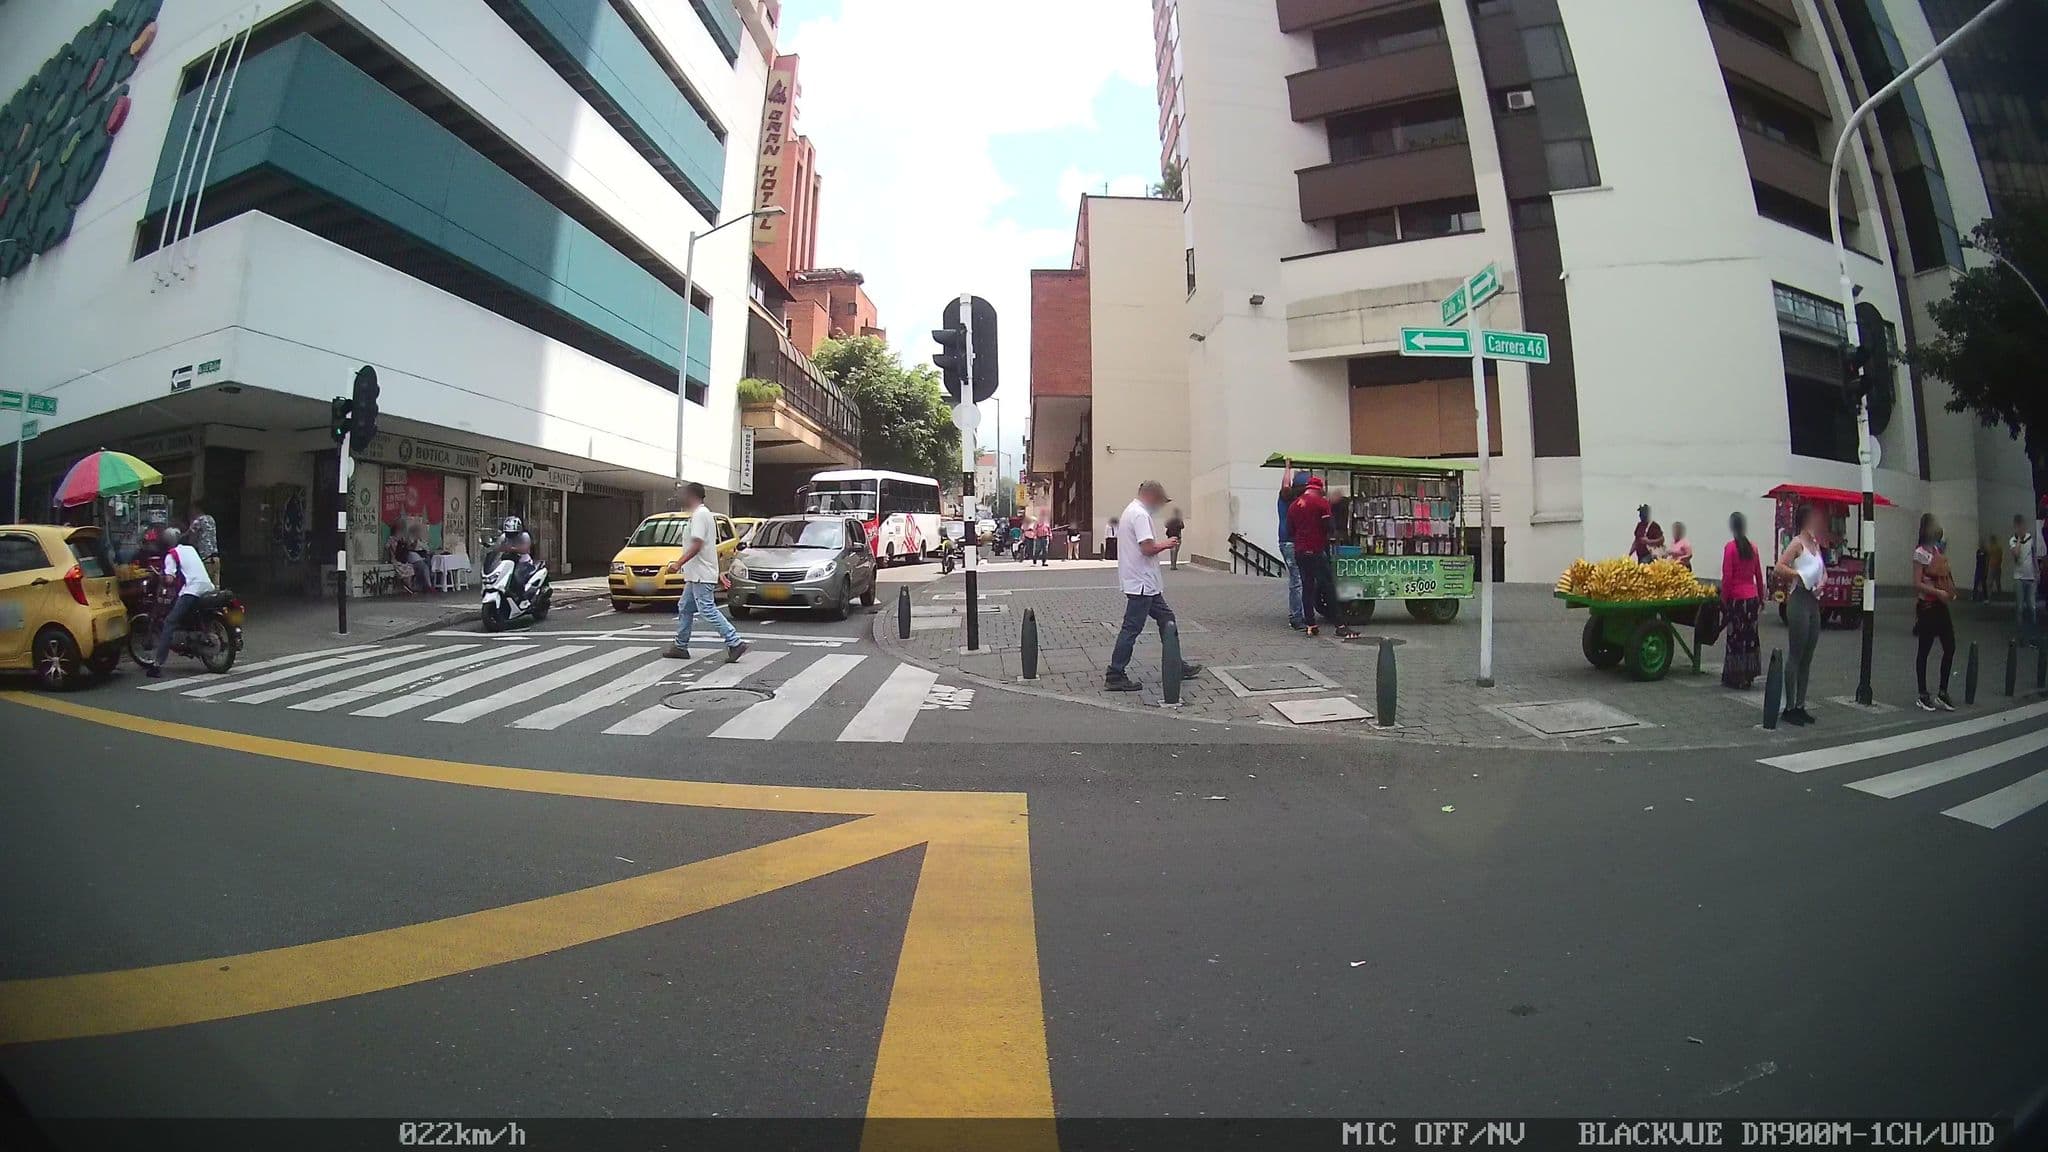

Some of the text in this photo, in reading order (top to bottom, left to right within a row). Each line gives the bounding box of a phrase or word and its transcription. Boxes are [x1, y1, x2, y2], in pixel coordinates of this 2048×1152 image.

[763, 110, 783, 156] GRAN
[1488, 335, 1542, 356] Carrera 46
[416, 447, 479, 468] BOTICA JUNIN
[500, 462, 533, 479] PUNTO
[1336, 558, 1435, 577] PROMOCIONES
